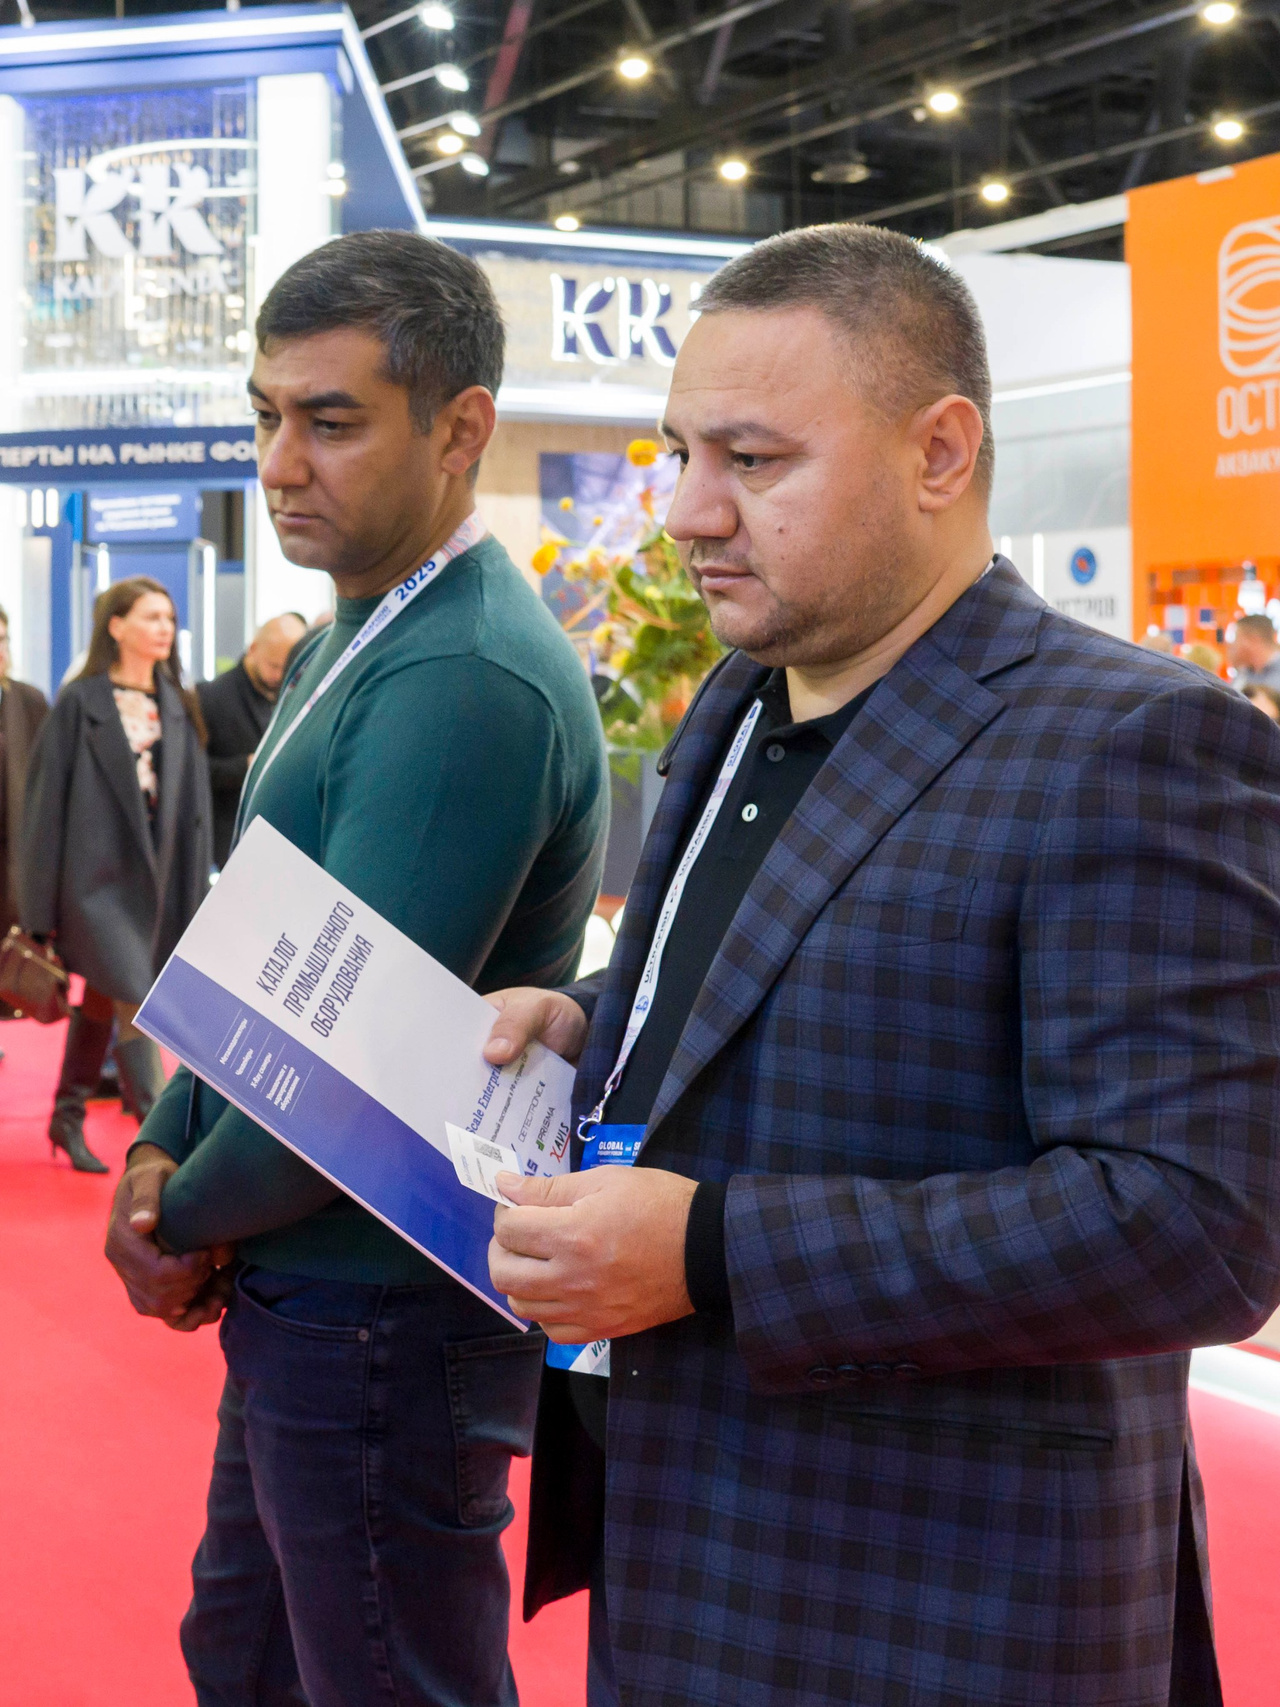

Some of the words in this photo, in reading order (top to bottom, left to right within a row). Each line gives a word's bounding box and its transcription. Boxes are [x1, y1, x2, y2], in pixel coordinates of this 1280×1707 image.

[78, 443, 116, 466] НА
[120, 441, 206, 465] РЫНКЕ
[395, 560, 437, 601] 2025
[256, 932, 298, 996] КАТАЛОГ
[282, 901, 354, 1018] ПРОМЫШЛЕННОГО
[644, 911, 671, 983] ULTRAFISH
[310, 934, 374, 1038] ОБОРУДОВАНИЯ
[465, 1108, 484, 1134] Scale
[539, 1106, 555, 1142] PRISMA
[598, 1141, 623, 1150] GLOBAL
